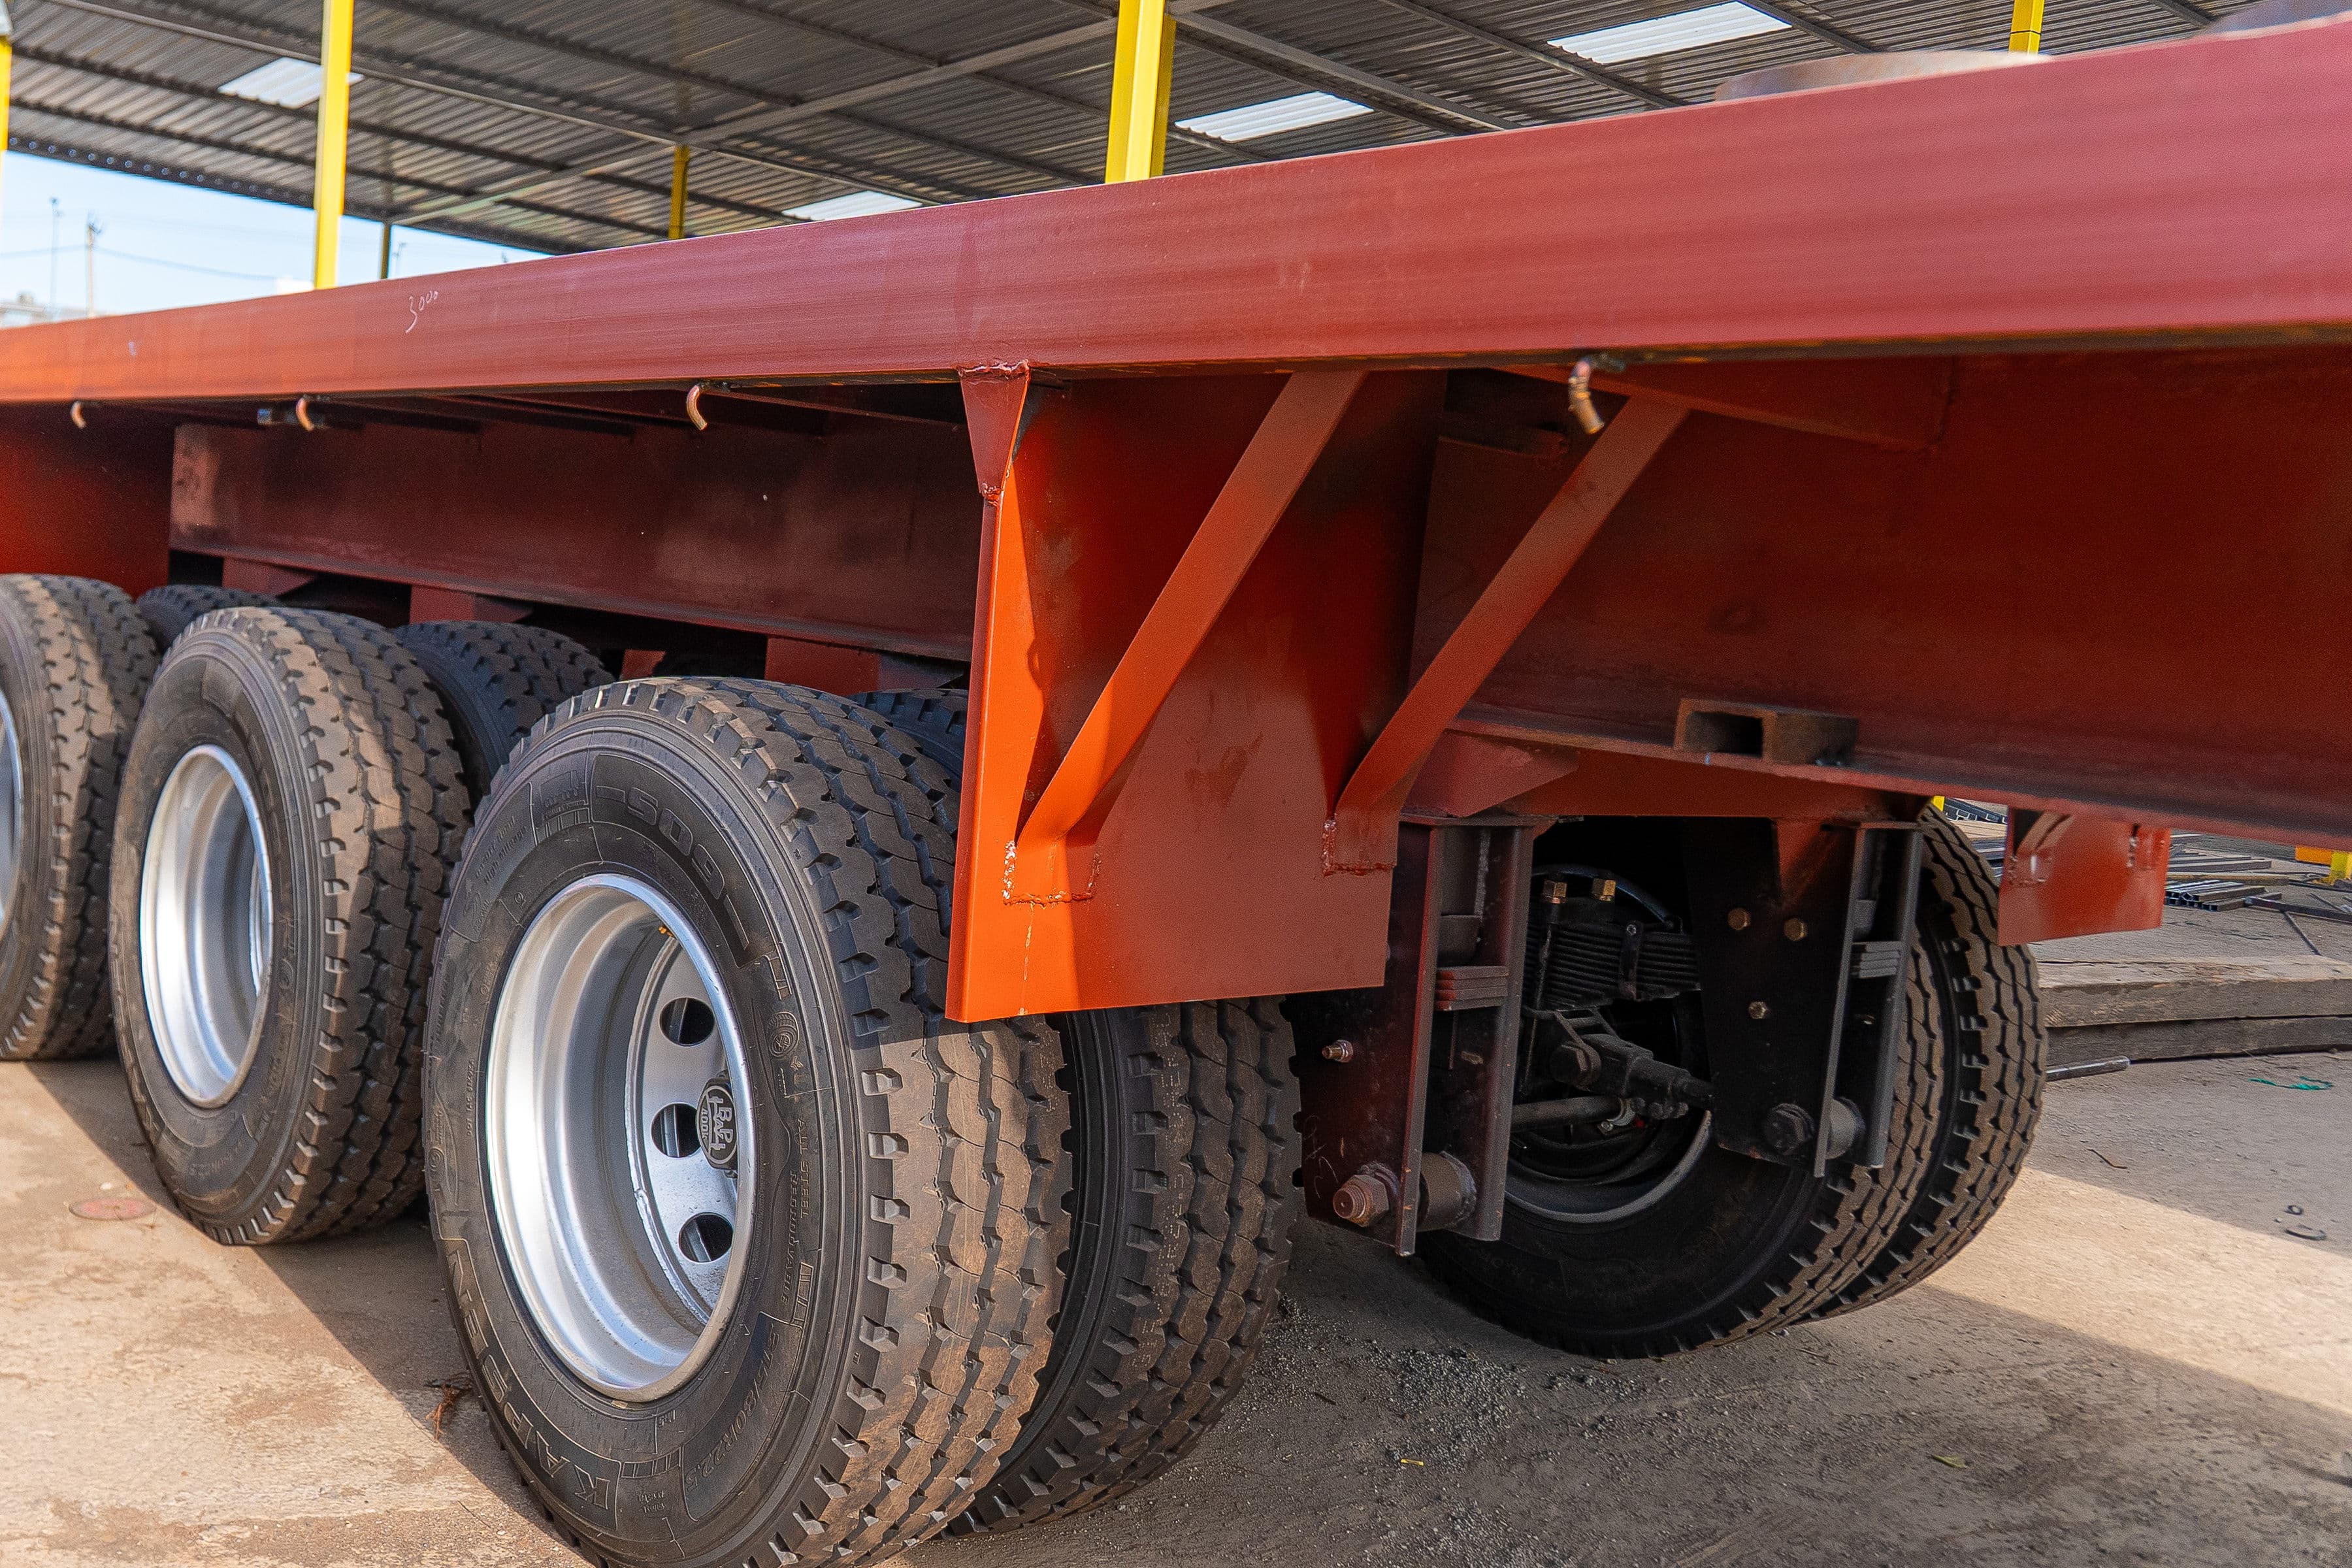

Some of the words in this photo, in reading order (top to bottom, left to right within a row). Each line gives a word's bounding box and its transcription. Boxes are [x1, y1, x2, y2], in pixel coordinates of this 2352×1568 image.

[404, 290, 439, 334] 3000
[800, 1160, 810, 1219] STEEL
[446, 1249, 610, 1511] KAPSEN
[685, 1323, 781, 1492] 315/80R22.5
